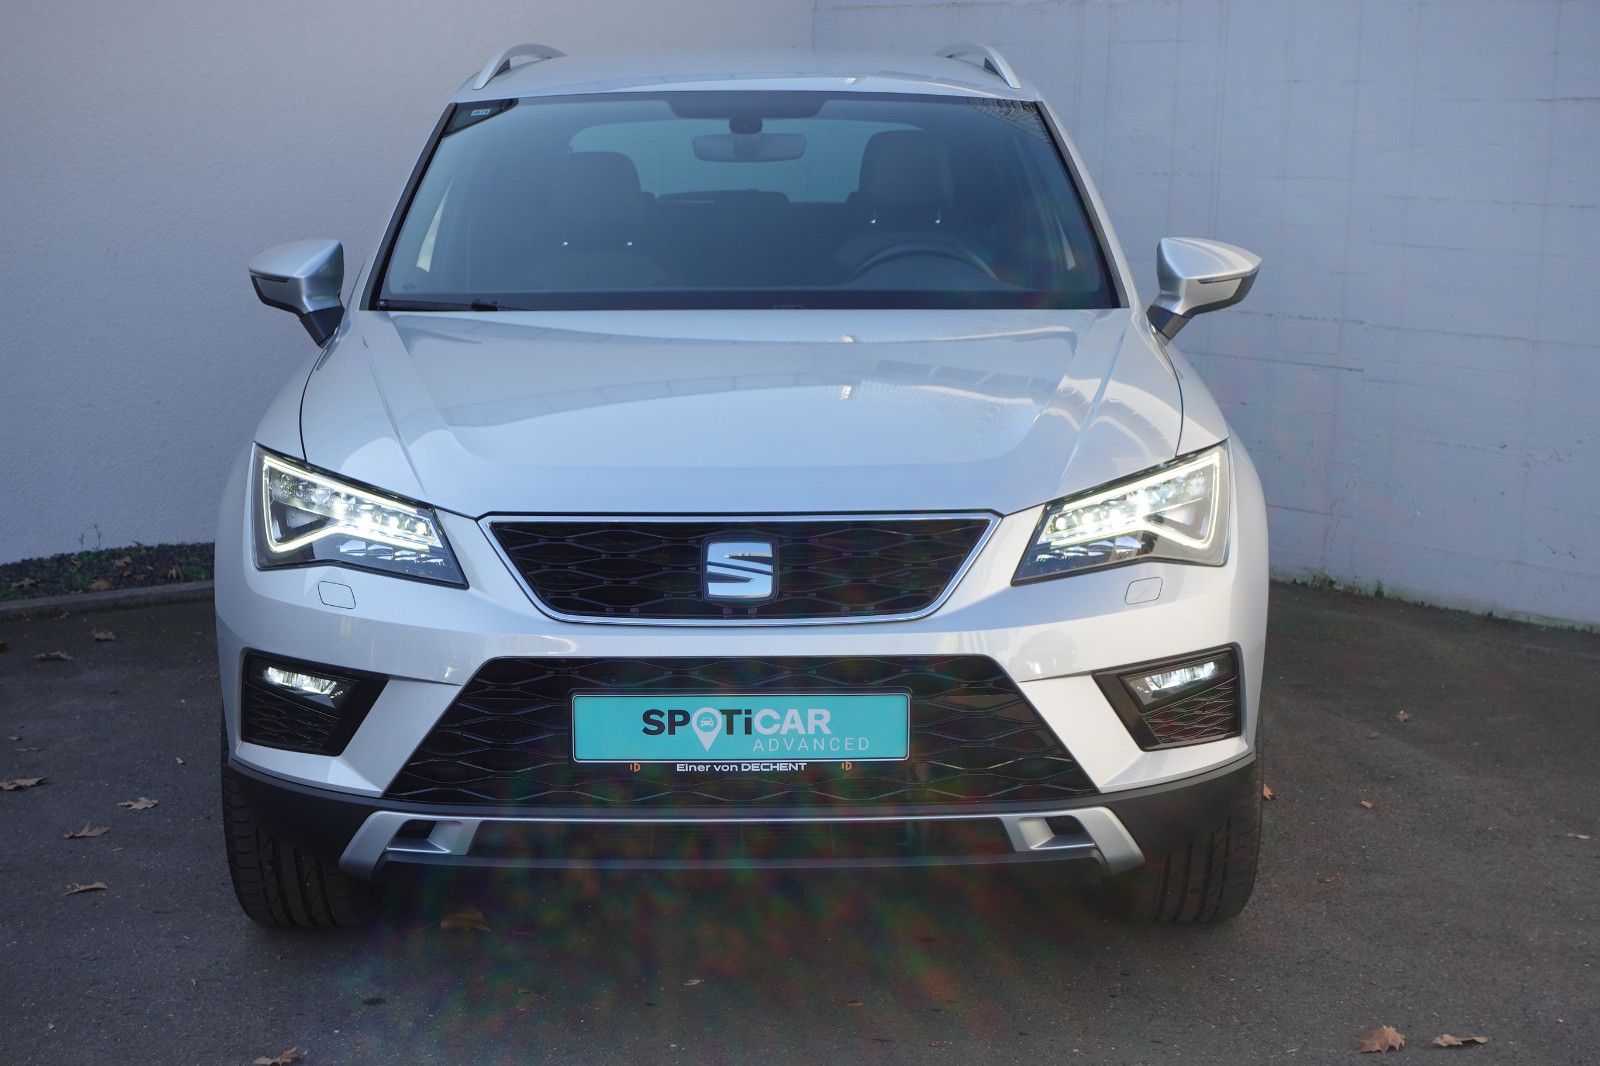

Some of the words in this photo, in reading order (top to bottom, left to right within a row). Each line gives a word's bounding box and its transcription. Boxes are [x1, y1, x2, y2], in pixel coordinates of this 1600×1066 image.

[753, 738, 870, 753] ADVANCED
[713, 764, 739, 772] von
[741, 762, 807, 772] DECHENT
